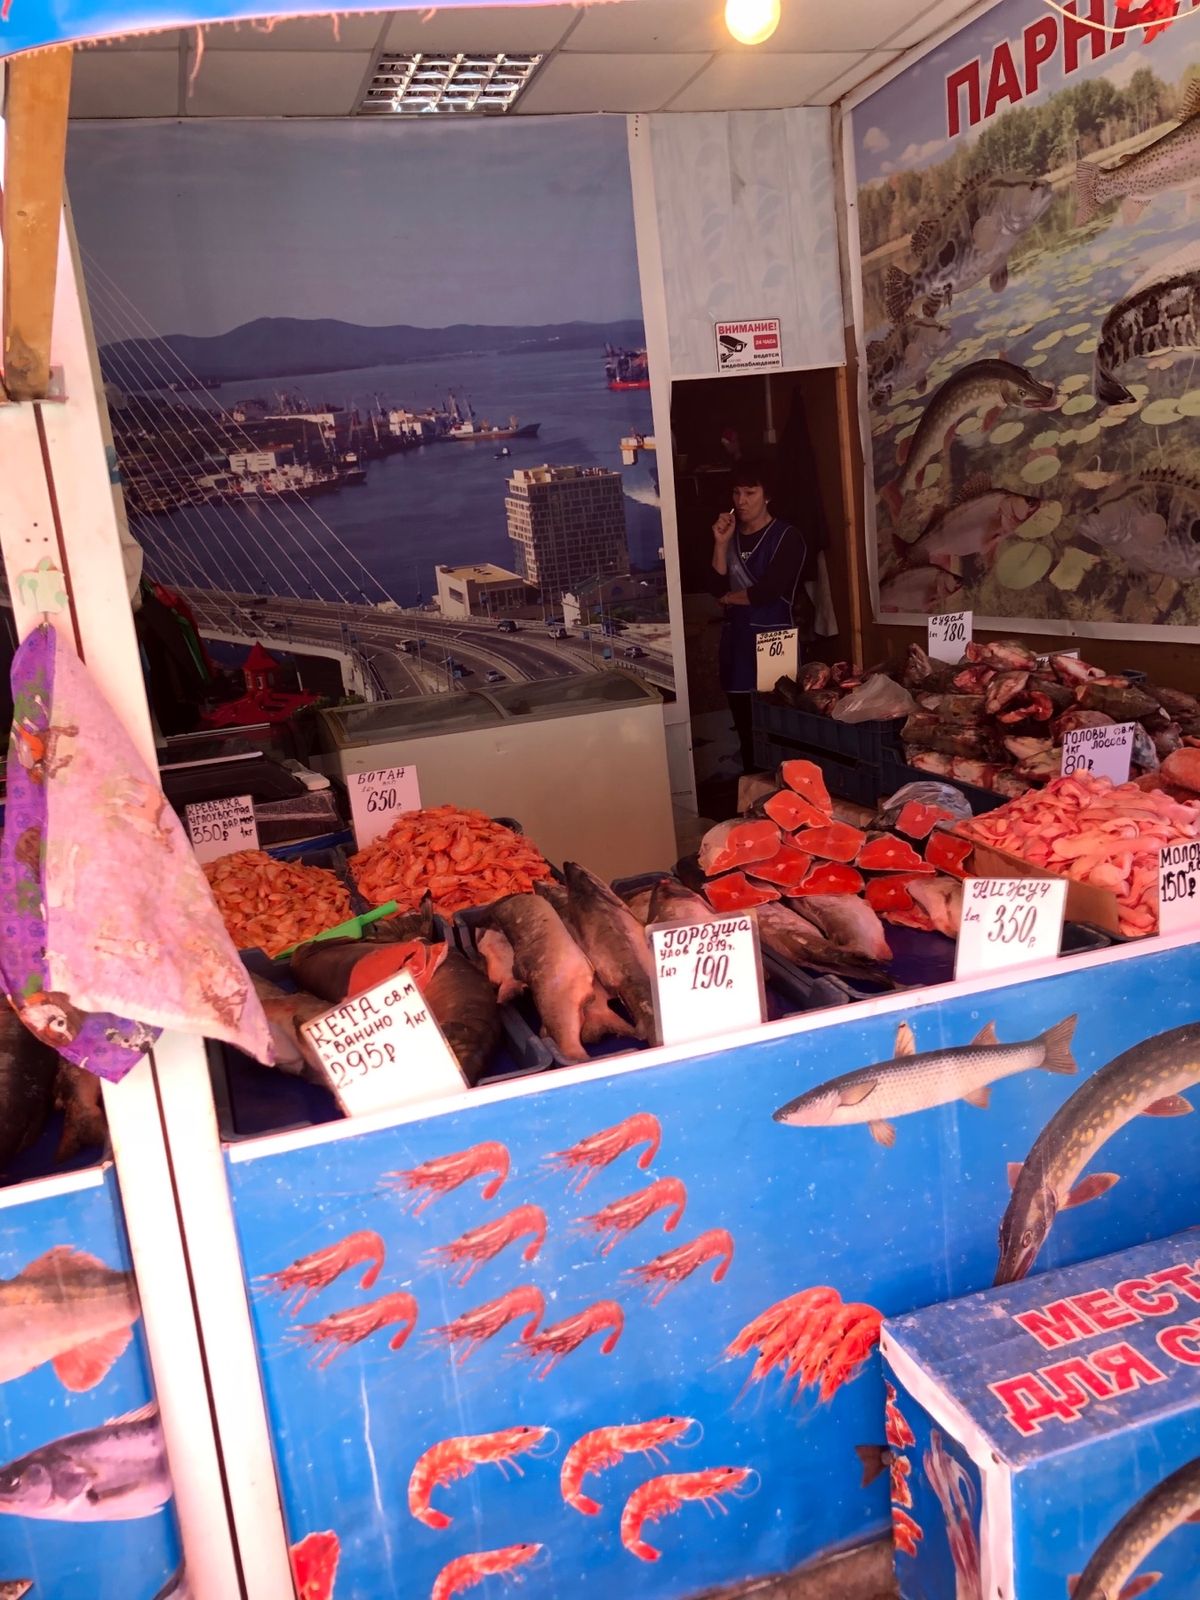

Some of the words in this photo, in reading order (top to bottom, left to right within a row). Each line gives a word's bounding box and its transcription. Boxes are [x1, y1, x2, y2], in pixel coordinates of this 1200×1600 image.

[947, 0, 1200, 138] ПАРН
[718, 322, 777, 335] ВНИМАНИЕ!
[1064, 728, 1107, 745] ГОЛОВЫ
[358, 768, 405, 784] БОТАН
[187, 798, 241, 816] КРЕВЕТКА
[306, 996, 380, 1048] КЕТА
[1012, 1260, 1200, 1350] МЕСТ
[987, 1342, 1169, 1437] ДЛЯ
[1156, 1318, 1200, 1366] С
